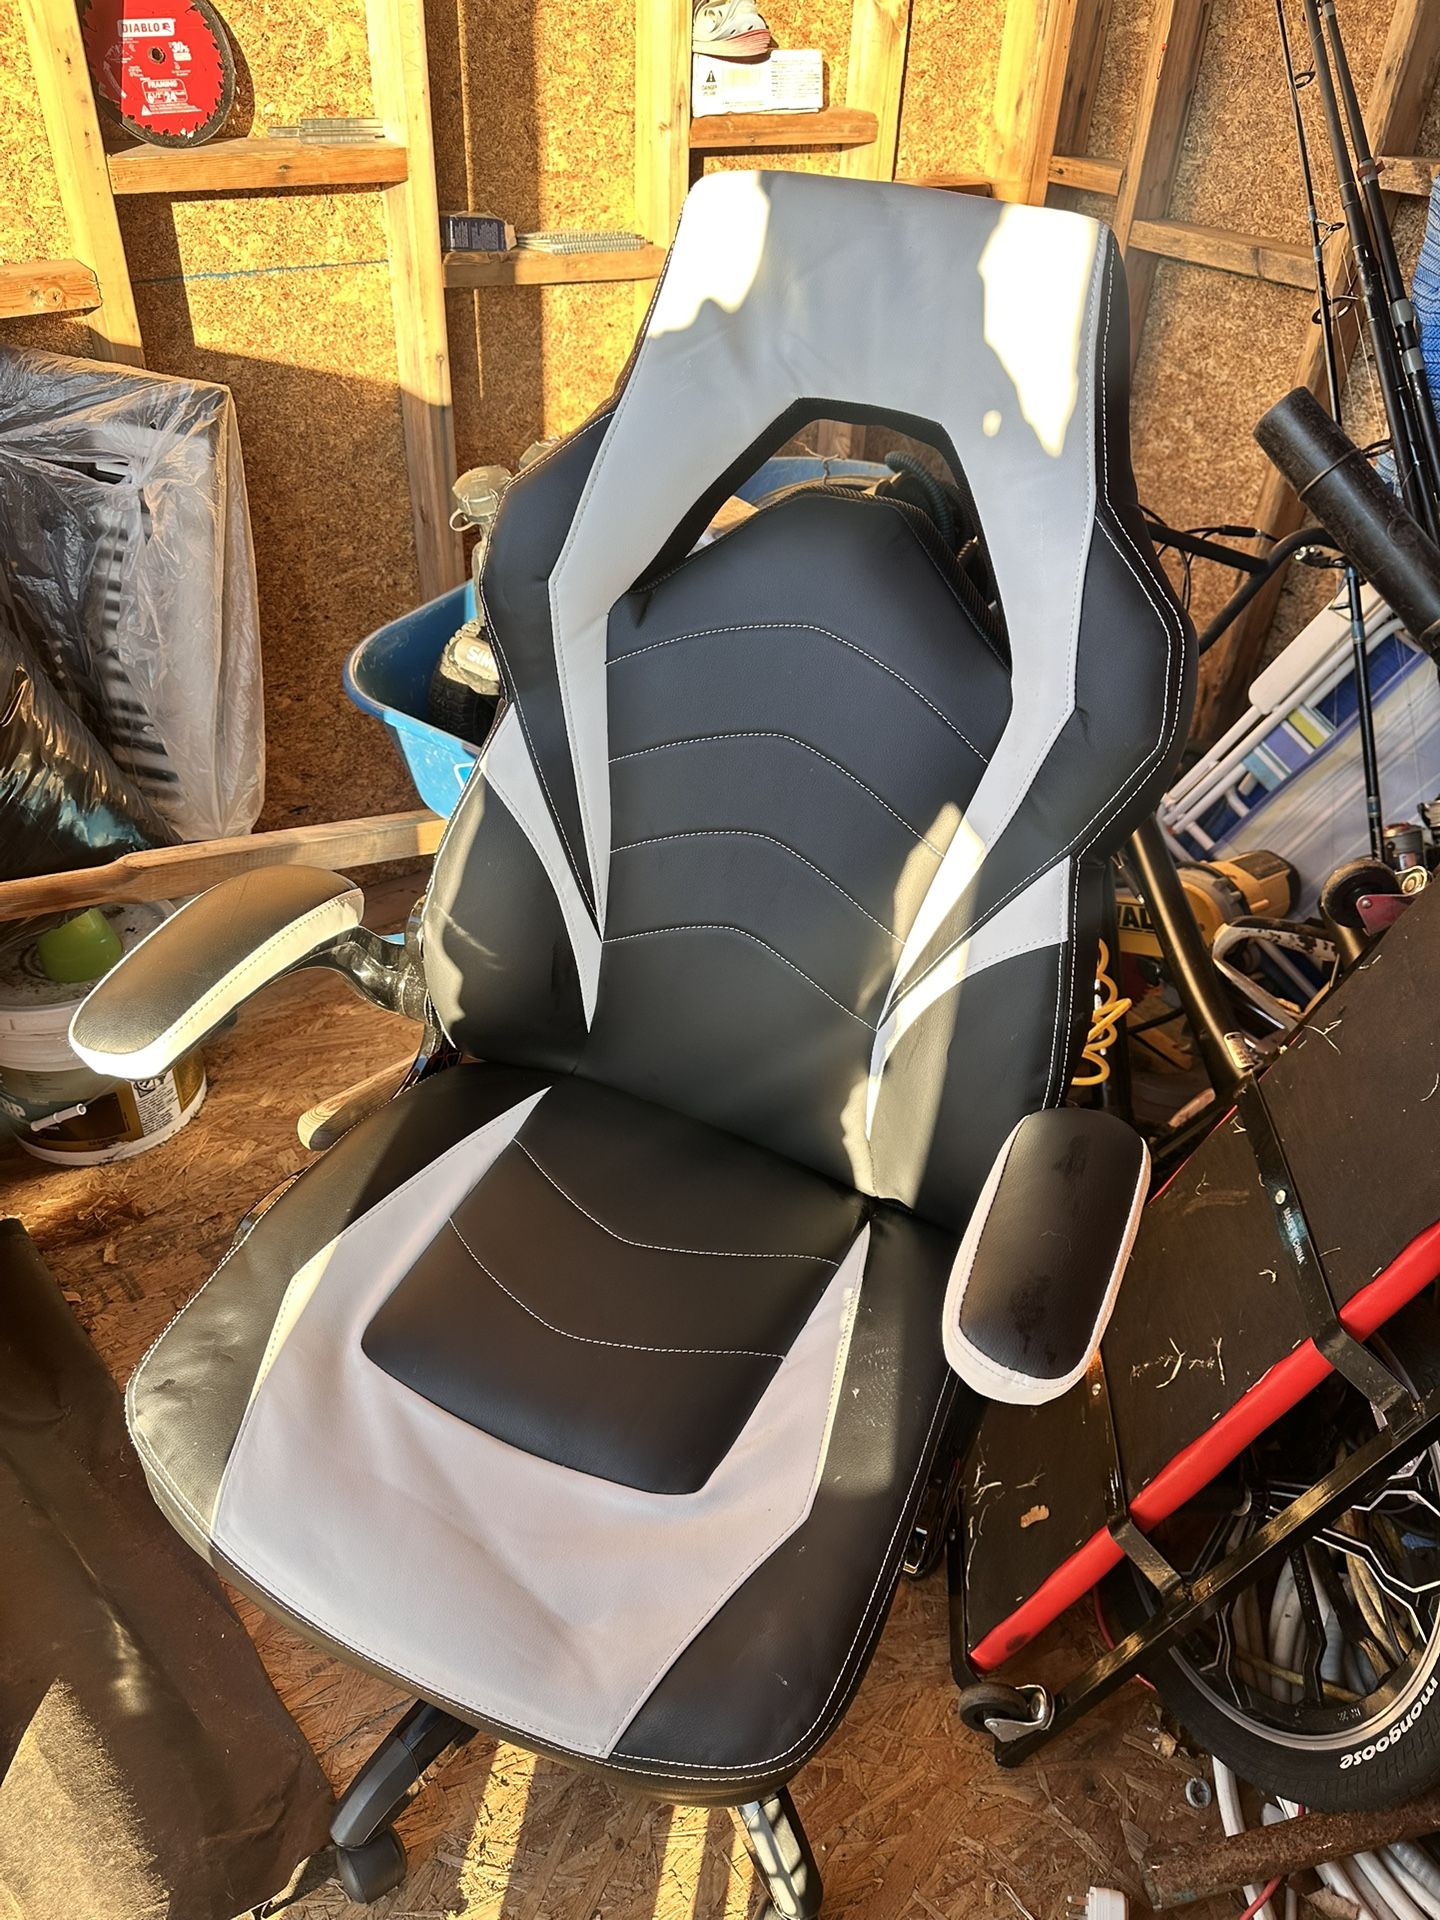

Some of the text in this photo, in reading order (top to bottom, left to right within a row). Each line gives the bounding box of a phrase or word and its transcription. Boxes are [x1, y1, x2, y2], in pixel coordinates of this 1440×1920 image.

[122, 22, 160, 33] DIABLO
[1283, 1207, 1295, 1230] MADE
[1292, 1238, 1305, 1265] CHINA
[1339, 1676, 1439, 1770] mongoose
